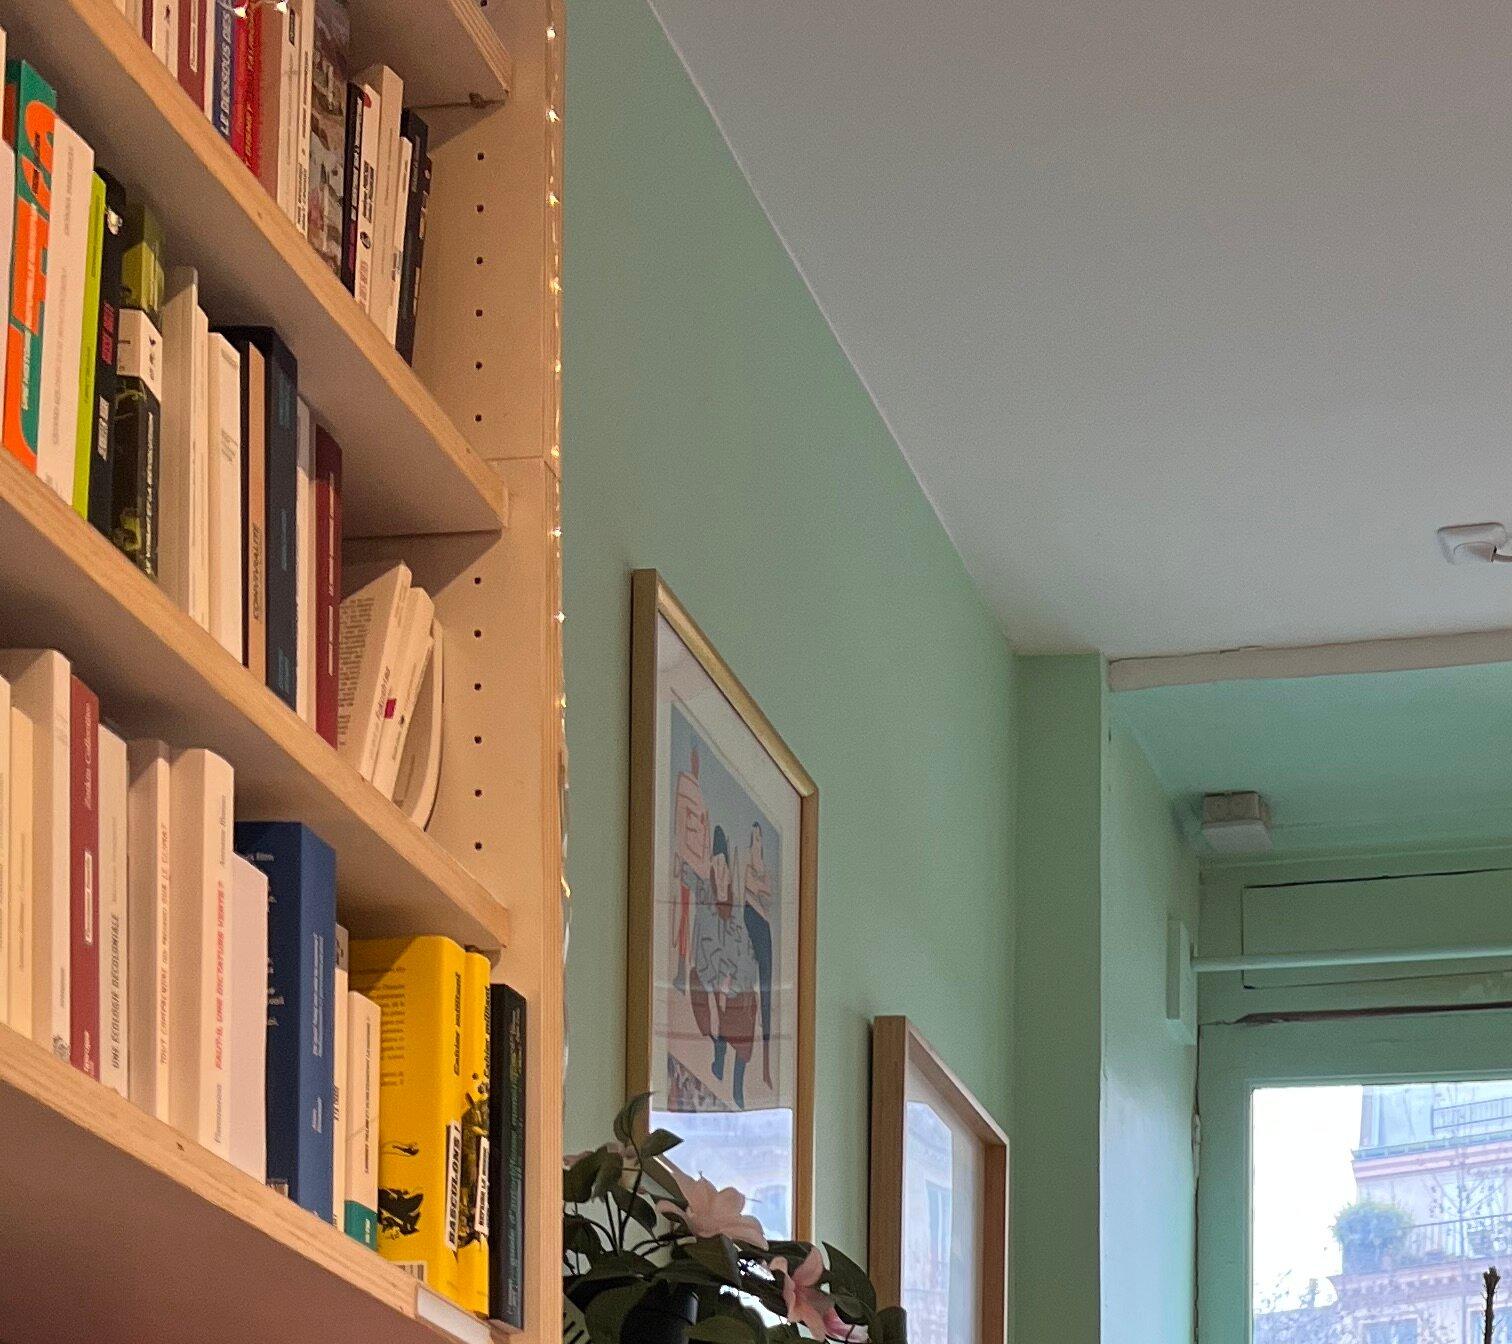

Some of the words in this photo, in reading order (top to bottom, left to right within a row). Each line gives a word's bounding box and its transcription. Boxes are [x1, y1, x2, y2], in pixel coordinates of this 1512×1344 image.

[219, 45, 231, 114] DESSOUS
[219, 113, 230, 137] LE
[448, 1137, 461, 1246] BASCULONS
